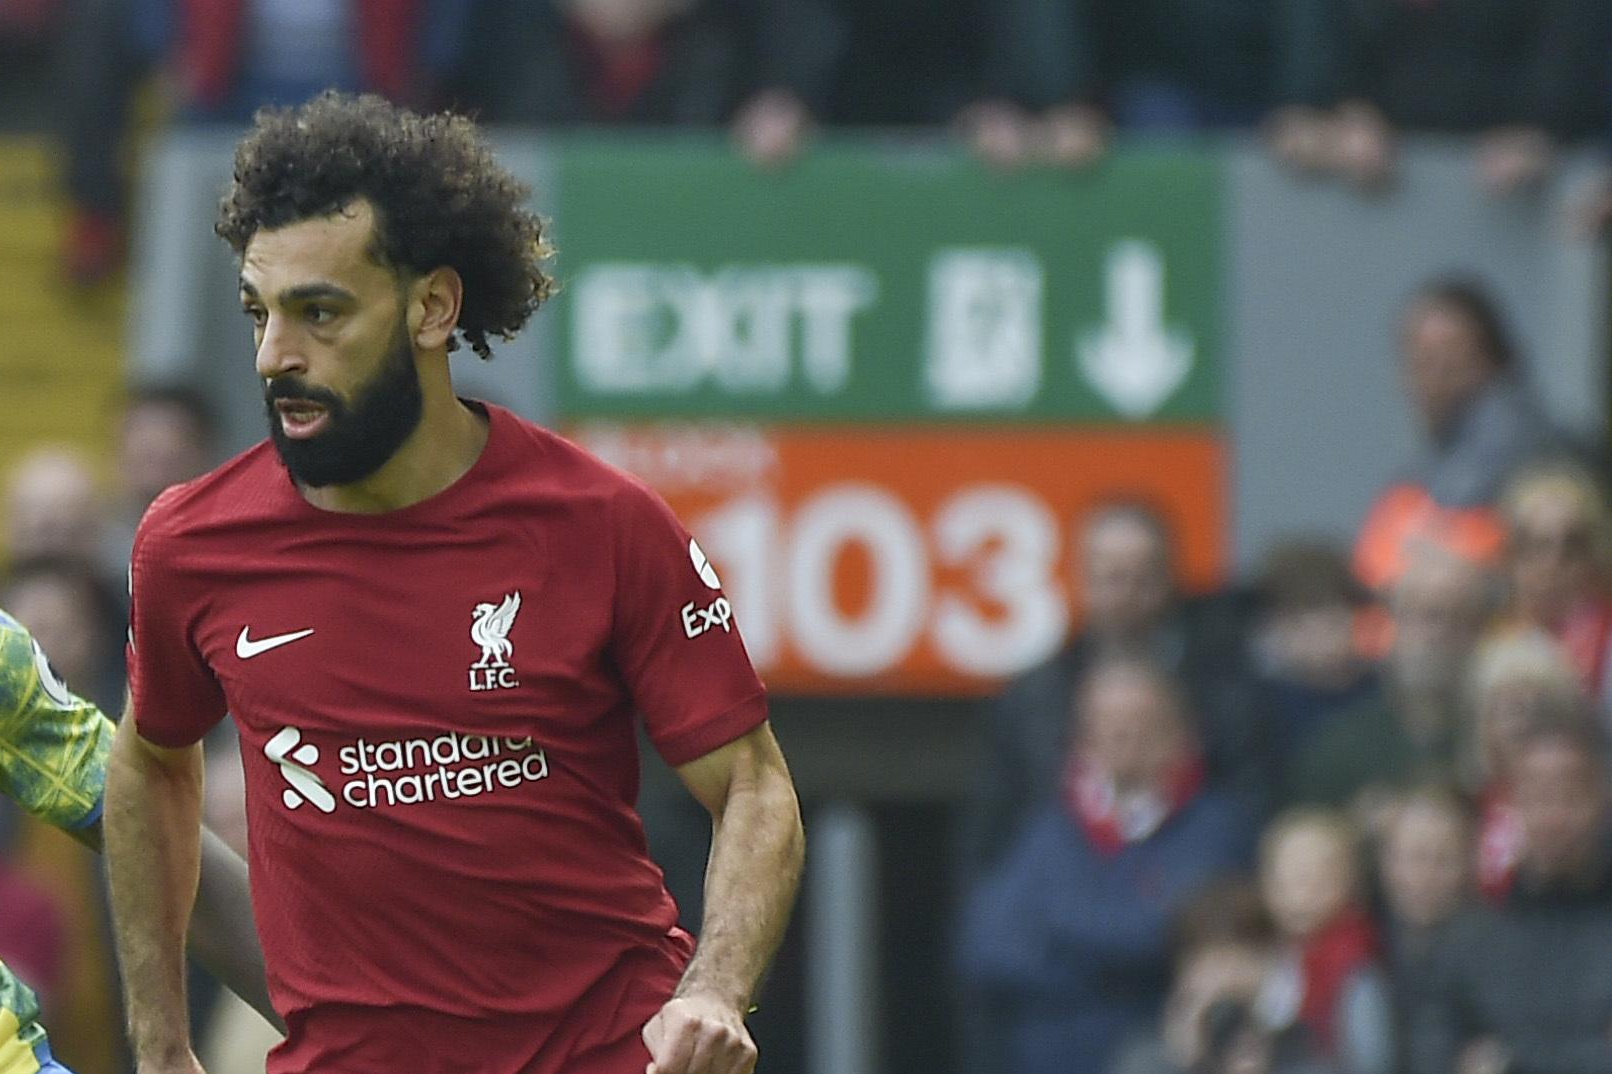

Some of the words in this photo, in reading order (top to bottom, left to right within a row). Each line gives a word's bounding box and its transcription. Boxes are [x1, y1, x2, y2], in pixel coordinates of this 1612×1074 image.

[574, 262, 876, 393] EXIT
[696, 486, 1066, 677] 103
[343, 749, 548, 807] chartered
